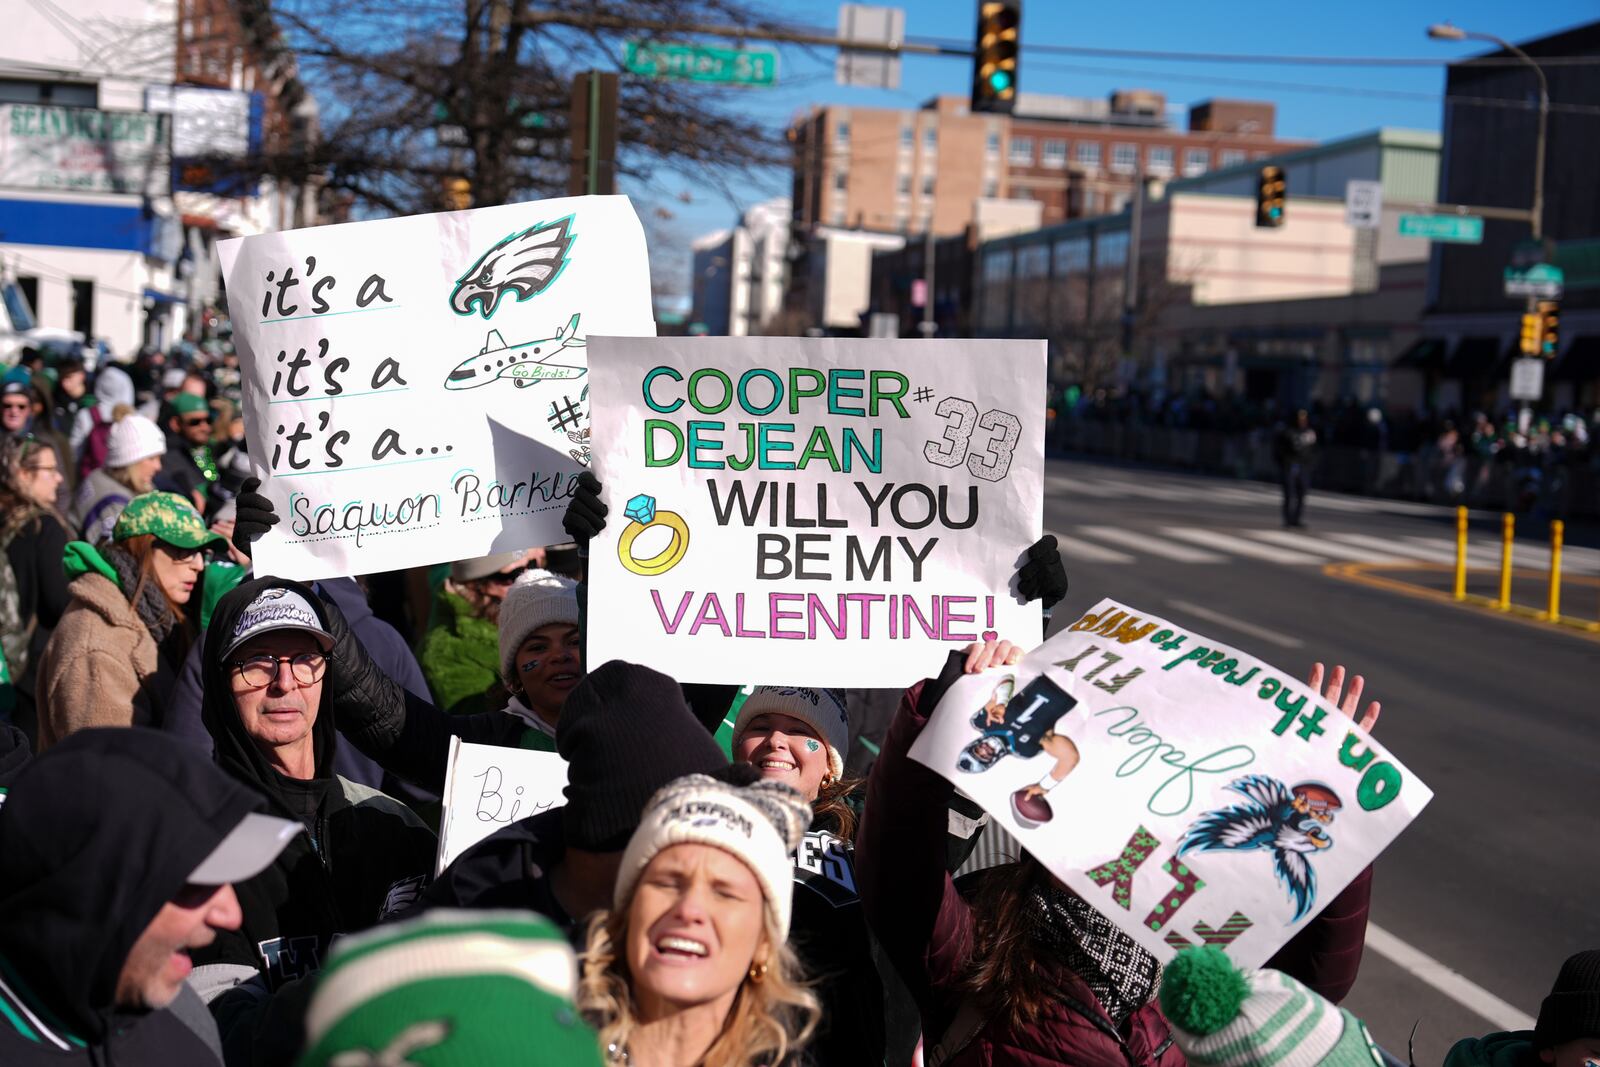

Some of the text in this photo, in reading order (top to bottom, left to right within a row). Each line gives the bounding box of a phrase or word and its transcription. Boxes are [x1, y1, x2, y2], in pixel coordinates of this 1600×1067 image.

[262, 256, 394, 318] it's a
[272, 338, 408, 396] it's a
[512, 364, 571, 378] Go Birds!
[642, 366, 912, 419] COOPER
[271, 411, 351, 470] it's
[645, 419, 882, 474] DEJEAN
[290, 472, 579, 549] Saquon Barkle
[706, 479, 978, 530] WILL YOU
[756, 534, 940, 583] BE MY
[650, 589, 1000, 642] VALENTINE!
[1150, 629, 1188, 651] to
[1052, 644, 1147, 695] FLY
[1161, 646, 1262, 687] road
[1258, 677, 1329, 742] the
[1338, 729, 1403, 812] On
[1084, 823, 1255, 951] FLY
